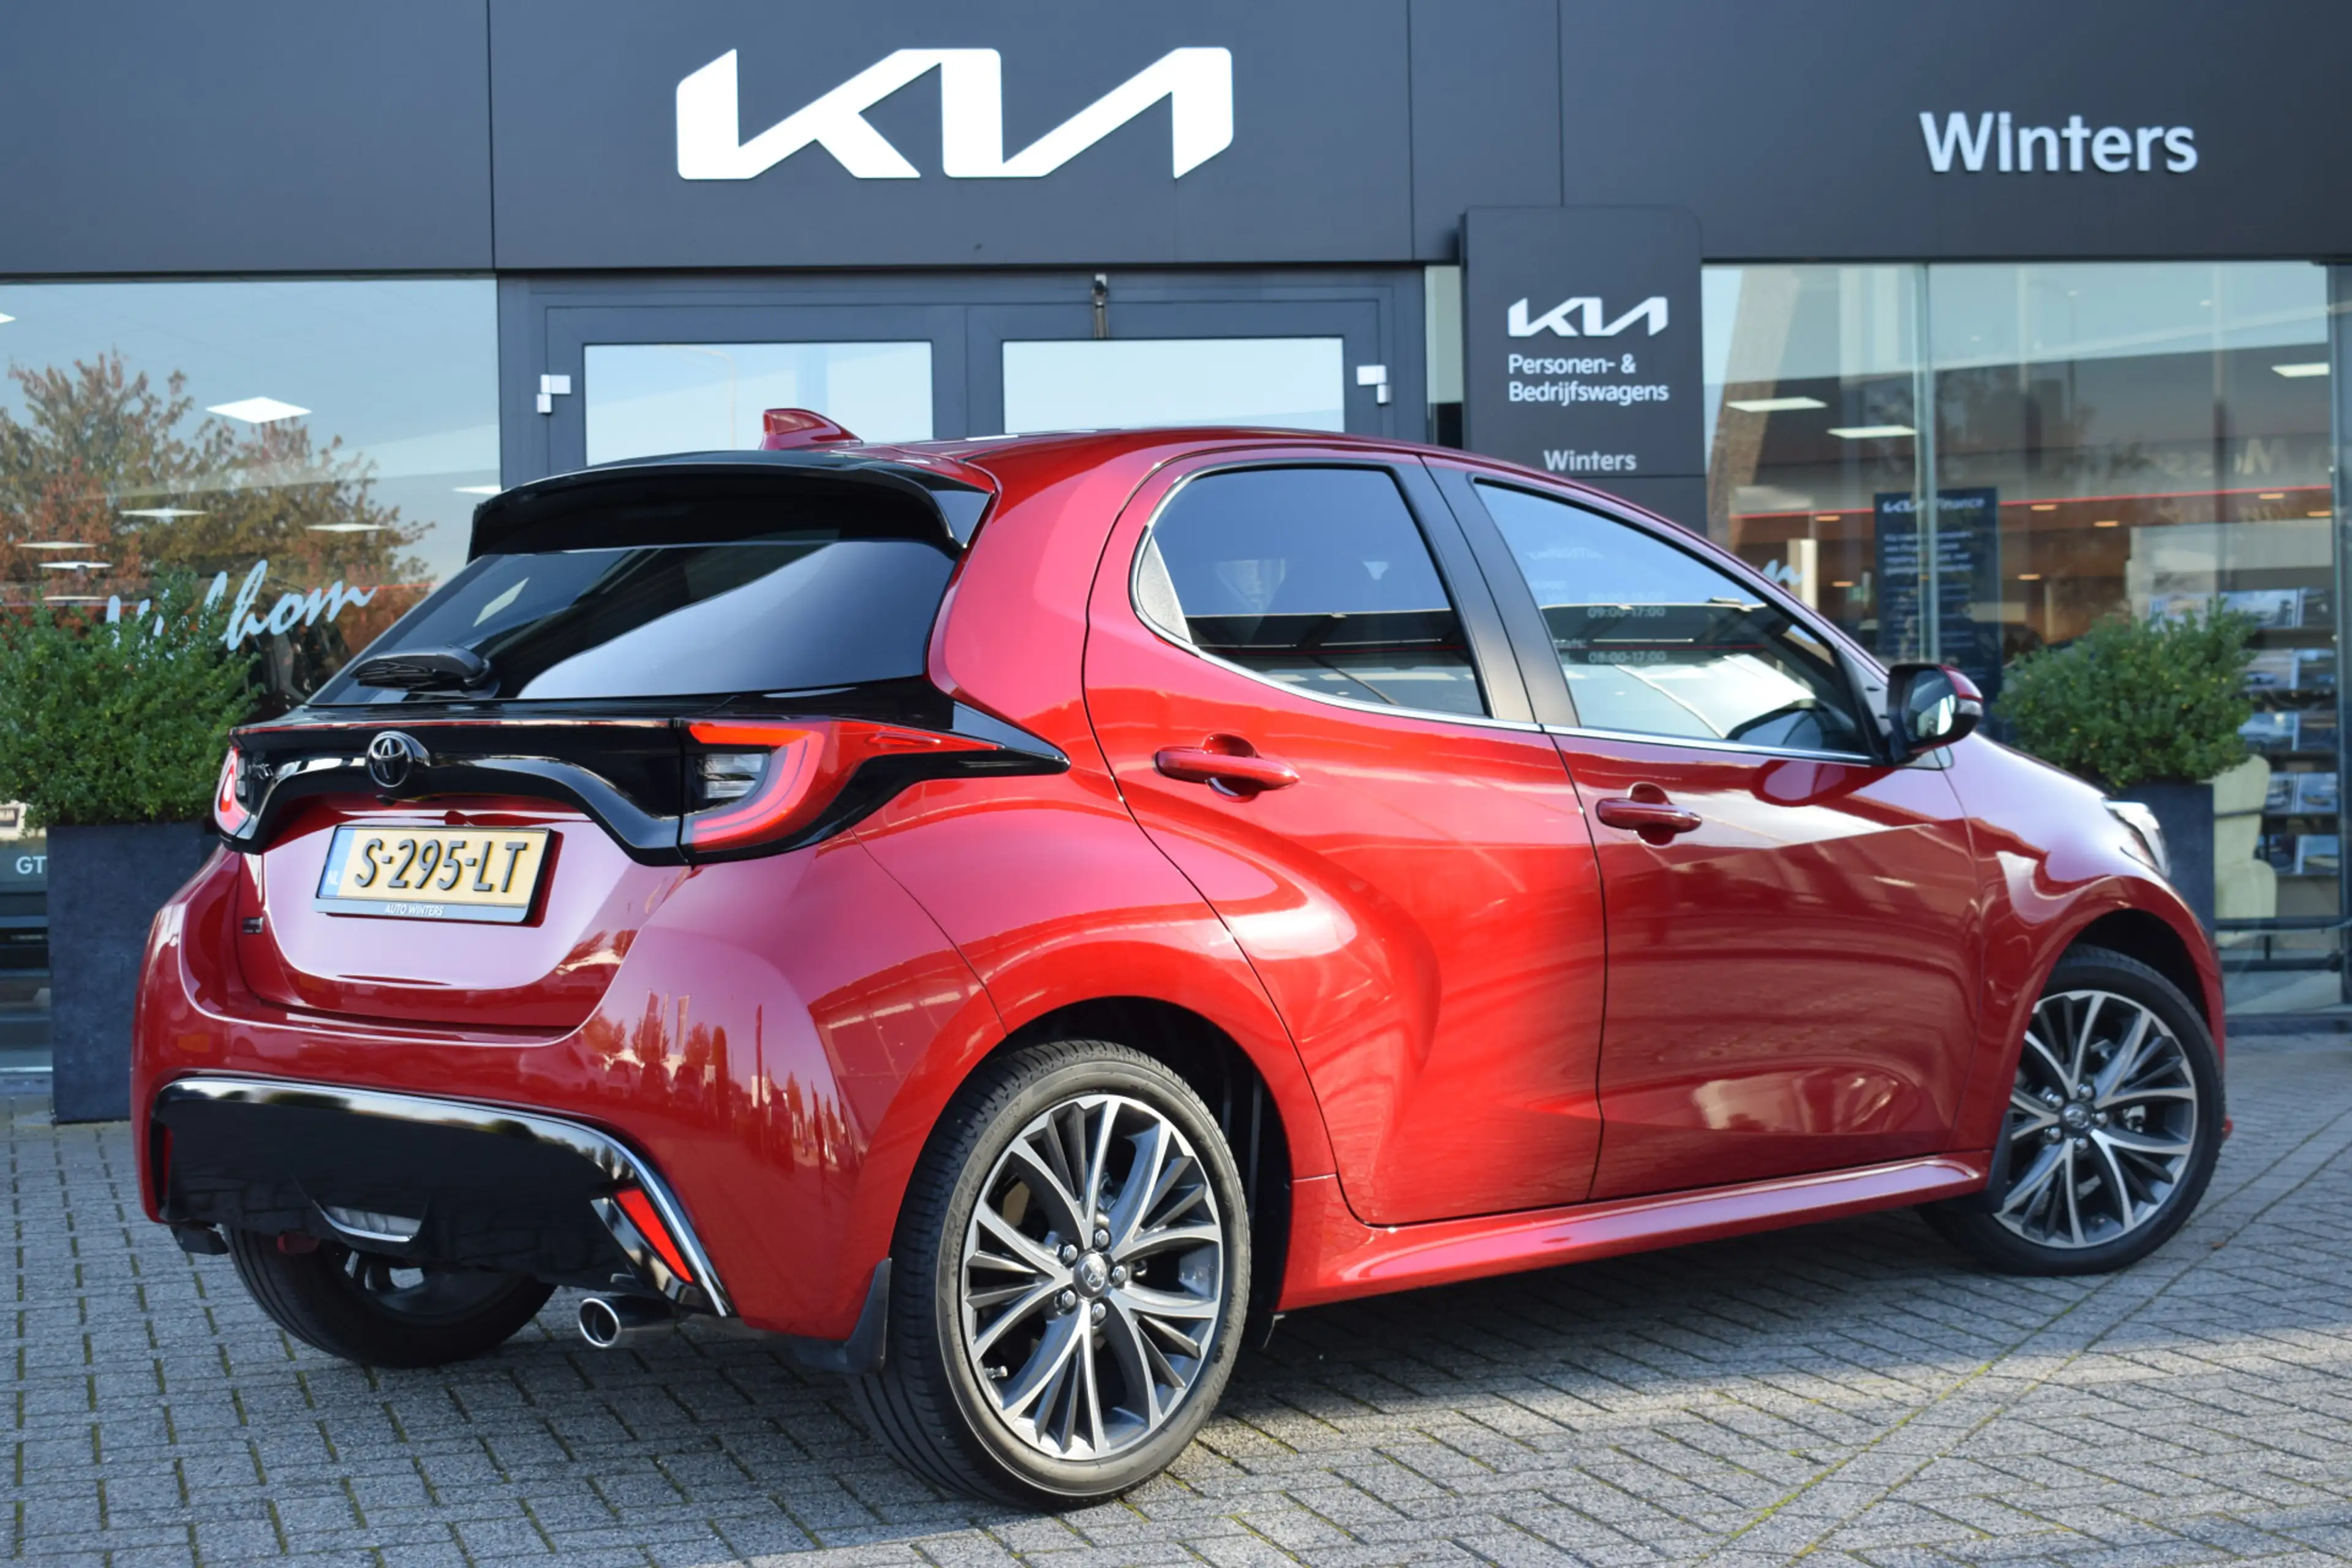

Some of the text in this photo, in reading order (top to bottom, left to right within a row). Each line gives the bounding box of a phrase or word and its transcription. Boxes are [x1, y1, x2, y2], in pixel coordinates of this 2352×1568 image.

[676, 47, 1234, 179] KIA
[1918, 111, 2198, 173] Winters
[1507, 296, 1668, 337] KIA
[1508, 353, 1636, 374] Personen- &
[1509, 380, 1669, 406] Bedrijfswagens
[1543, 450, 1637, 471] Winters
[355, 837, 529, 892] S-295-LT
[384, 903, 444, 917] AUTO WINTERS
